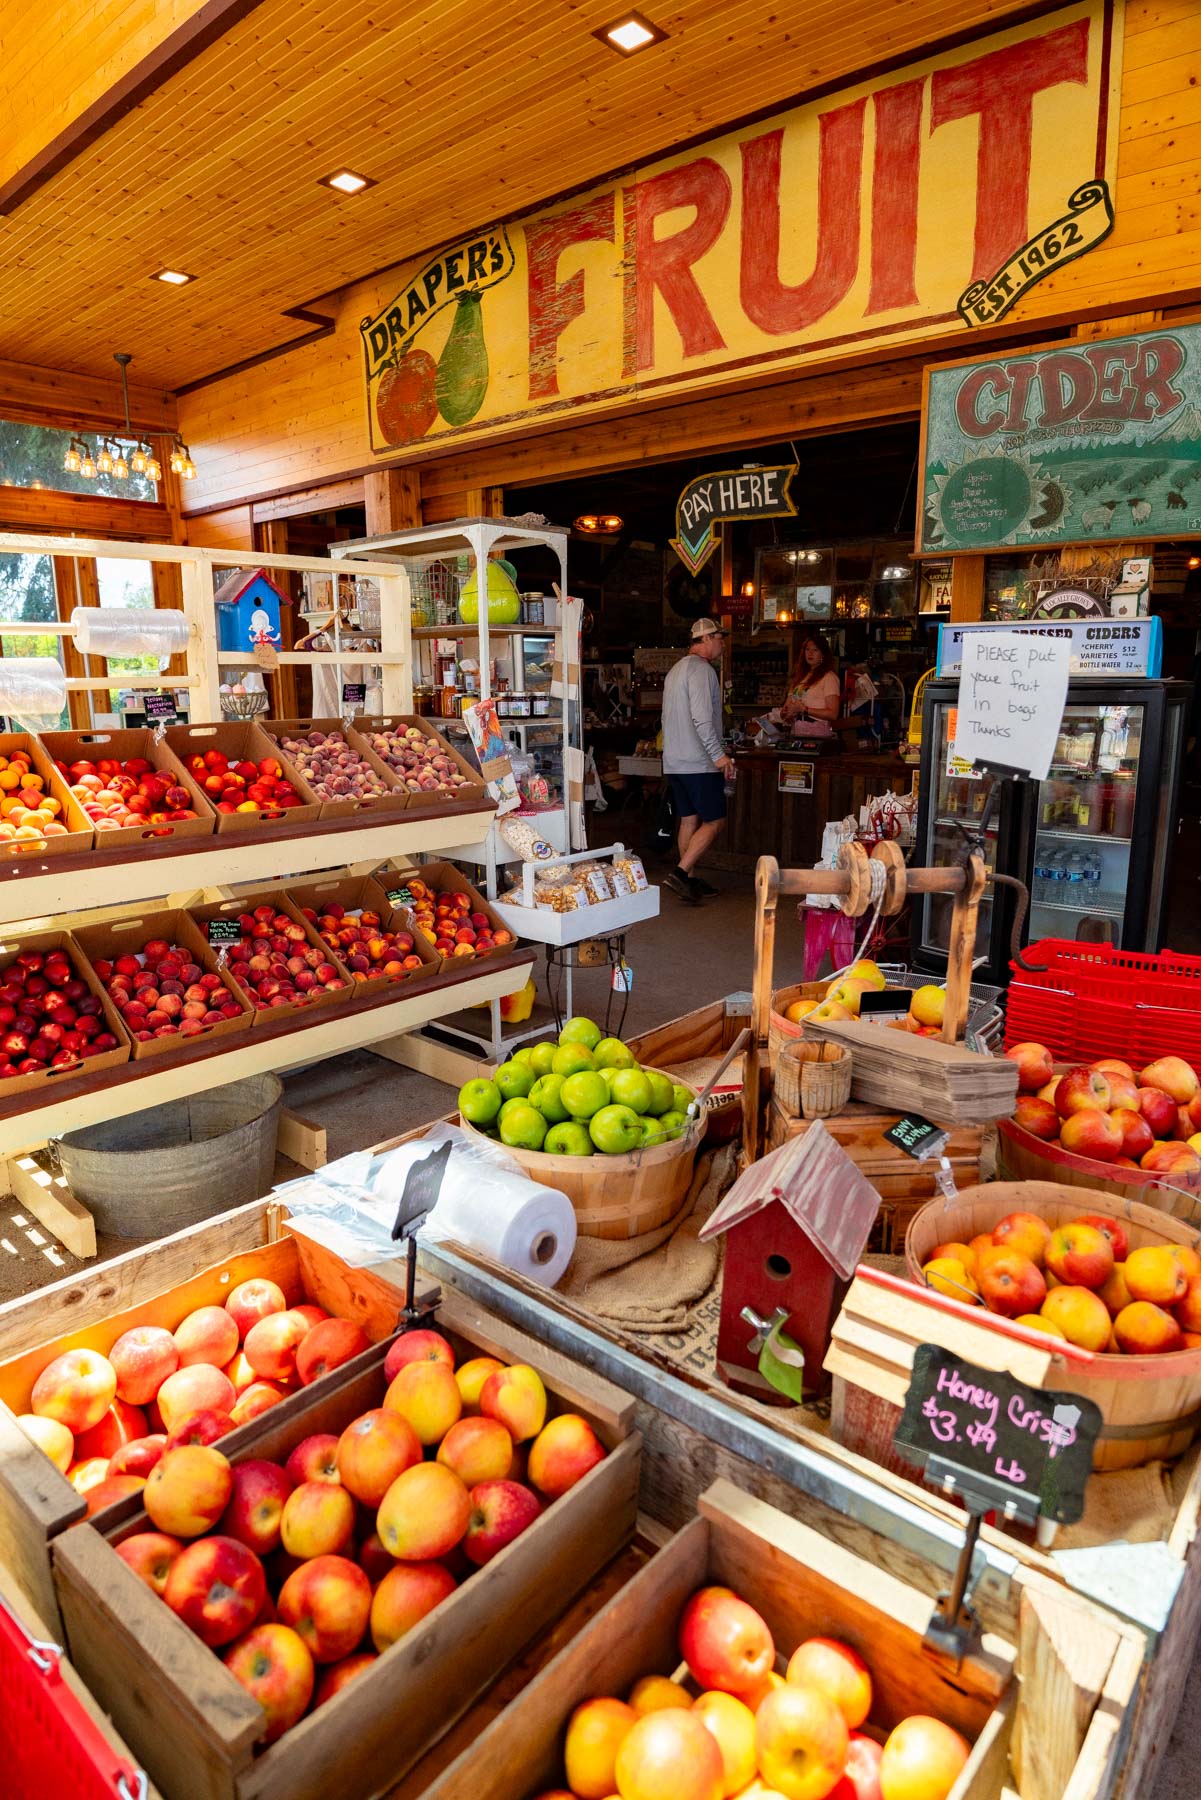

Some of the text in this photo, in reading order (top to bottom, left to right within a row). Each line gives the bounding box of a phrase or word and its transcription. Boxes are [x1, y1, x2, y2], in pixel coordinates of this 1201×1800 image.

[525, 17, 1090, 400] FRUIT
[972, 223, 1083, 323] EST. 1962
[368, 237, 504, 364] DRAPER'S
[955, 336, 1187, 439] CIDER
[681, 471, 779, 529] PAY HERE
[1045, 594, 1090, 609] LOCALLY GROWN
[1012, 626, 1141, 640] SSED CIDERS
[1028, 647, 1057, 669] put
[1010, 669, 1040, 692] fruit
[973, 697, 991, 711] in
[968, 720, 1012, 738] Thanks
[891, 1119, 915, 1138] ENVY
[922, 1396, 997, 1454] $3.49
[936, 1368, 1077, 1459] Honey Crisp
